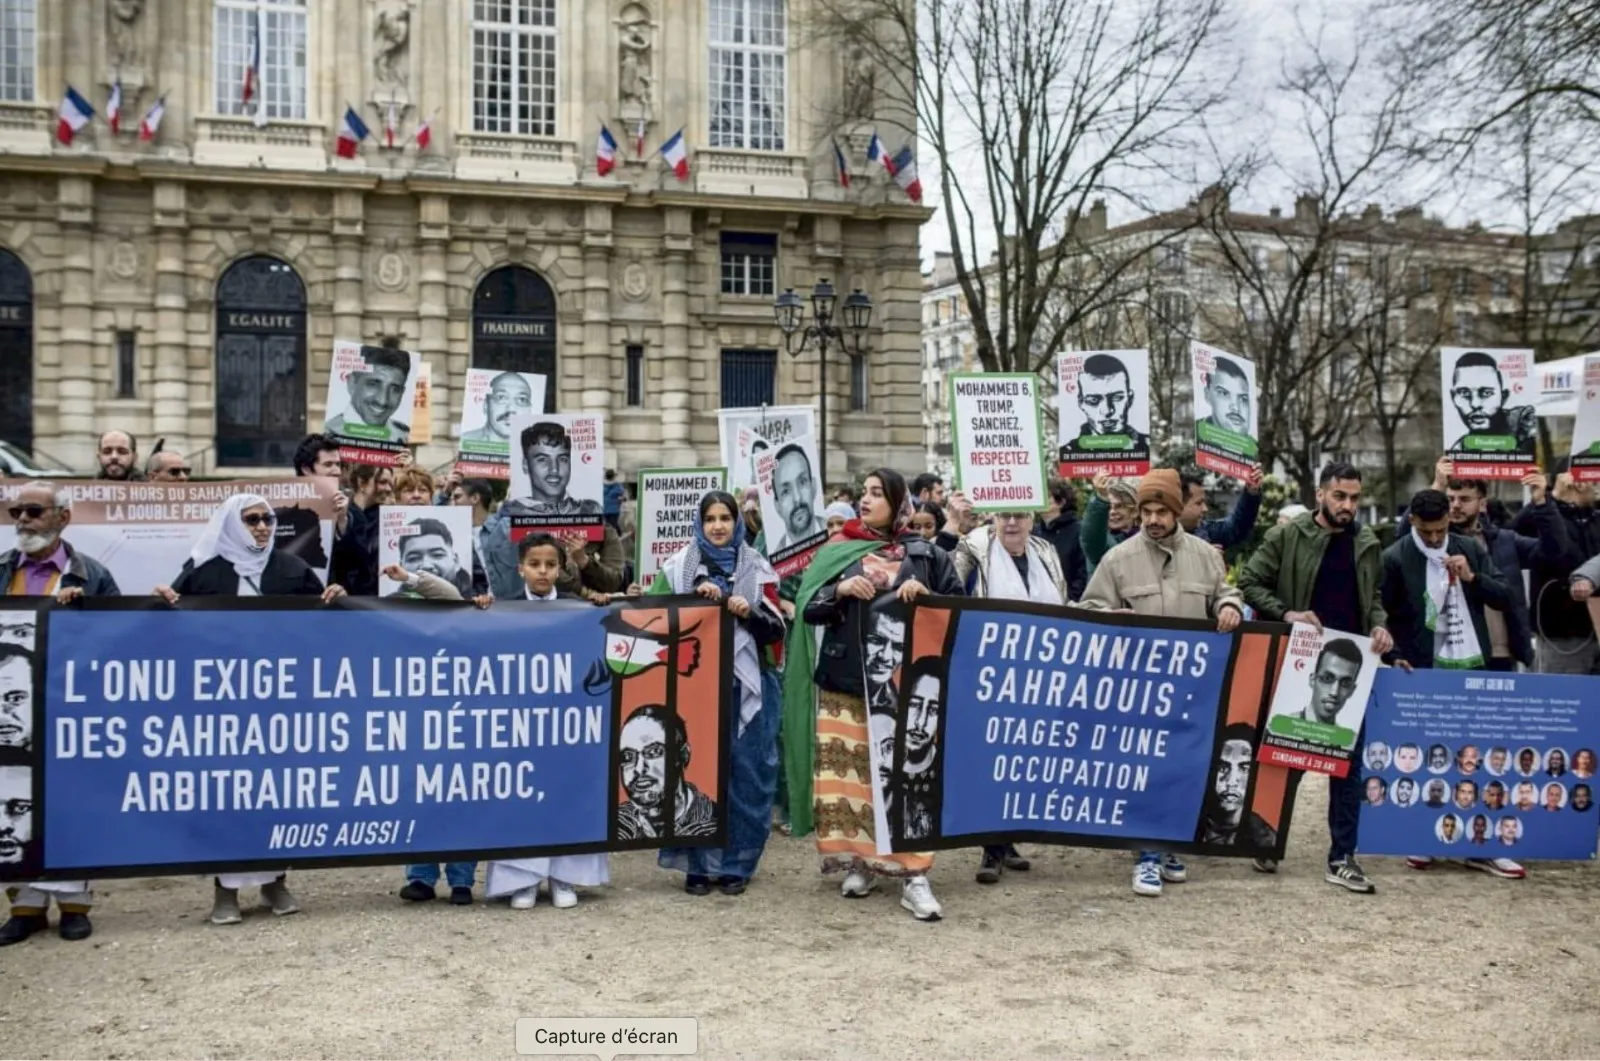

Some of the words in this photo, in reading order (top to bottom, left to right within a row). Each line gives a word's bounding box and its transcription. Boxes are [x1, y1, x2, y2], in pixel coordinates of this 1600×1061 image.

[957, 381, 1019, 396] MOHAMMED
[1022, 383, 1032, 397] 6,
[977, 400, 1014, 415] TRUMP,
[971, 417, 1023, 432] SANCHEZ,
[974, 435, 1023, 449] MACRON,
[970, 451, 1029, 466] RESPECTEZ
[645, 476, 707, 492] MOHAMMED
[711, 476, 720, 490] 6,
[991, 470, 1012, 483] LES
[129, 487, 165, 501] HORS
[168, 486, 185, 501] DU
[664, 492, 700, 507] TRUMP,
[972, 486, 1033, 501] SAHRAOUIS
[106, 504, 124, 520] LA
[128, 504, 179, 520] DOUBLE
[656, 509, 695, 523] SANCHE
[657, 526, 694, 539] MACRO
[978, 622, 1209, 678] PRISONNIERS
[64, 659, 176, 703] L'ONU
[193, 657, 297, 701] EXIGE
[313, 658, 356, 698] LA
[372, 650, 573, 698] LIBÉRATION
[55, 717, 126, 759] DES
[142, 712, 350, 757] SAHRAOUIS
[365, 710, 407, 752] EN
[422, 701, 603, 751] DÉTENTION
[985, 717, 1080, 749] OTAGES
[1091, 725, 1170, 757] D'UNE
[994, 755, 1149, 792] OCCUPATION
[121, 766, 340, 813] ARBITRAIRE
[353, 764, 399, 805] AU
[416, 760, 546, 804] MAROC,
[1003, 789, 1127, 826] ILLÉGALE
[269, 822, 326, 849] NOUS
[333, 821, 400, 847] AUSSI
[406, 820, 416, 844] !
